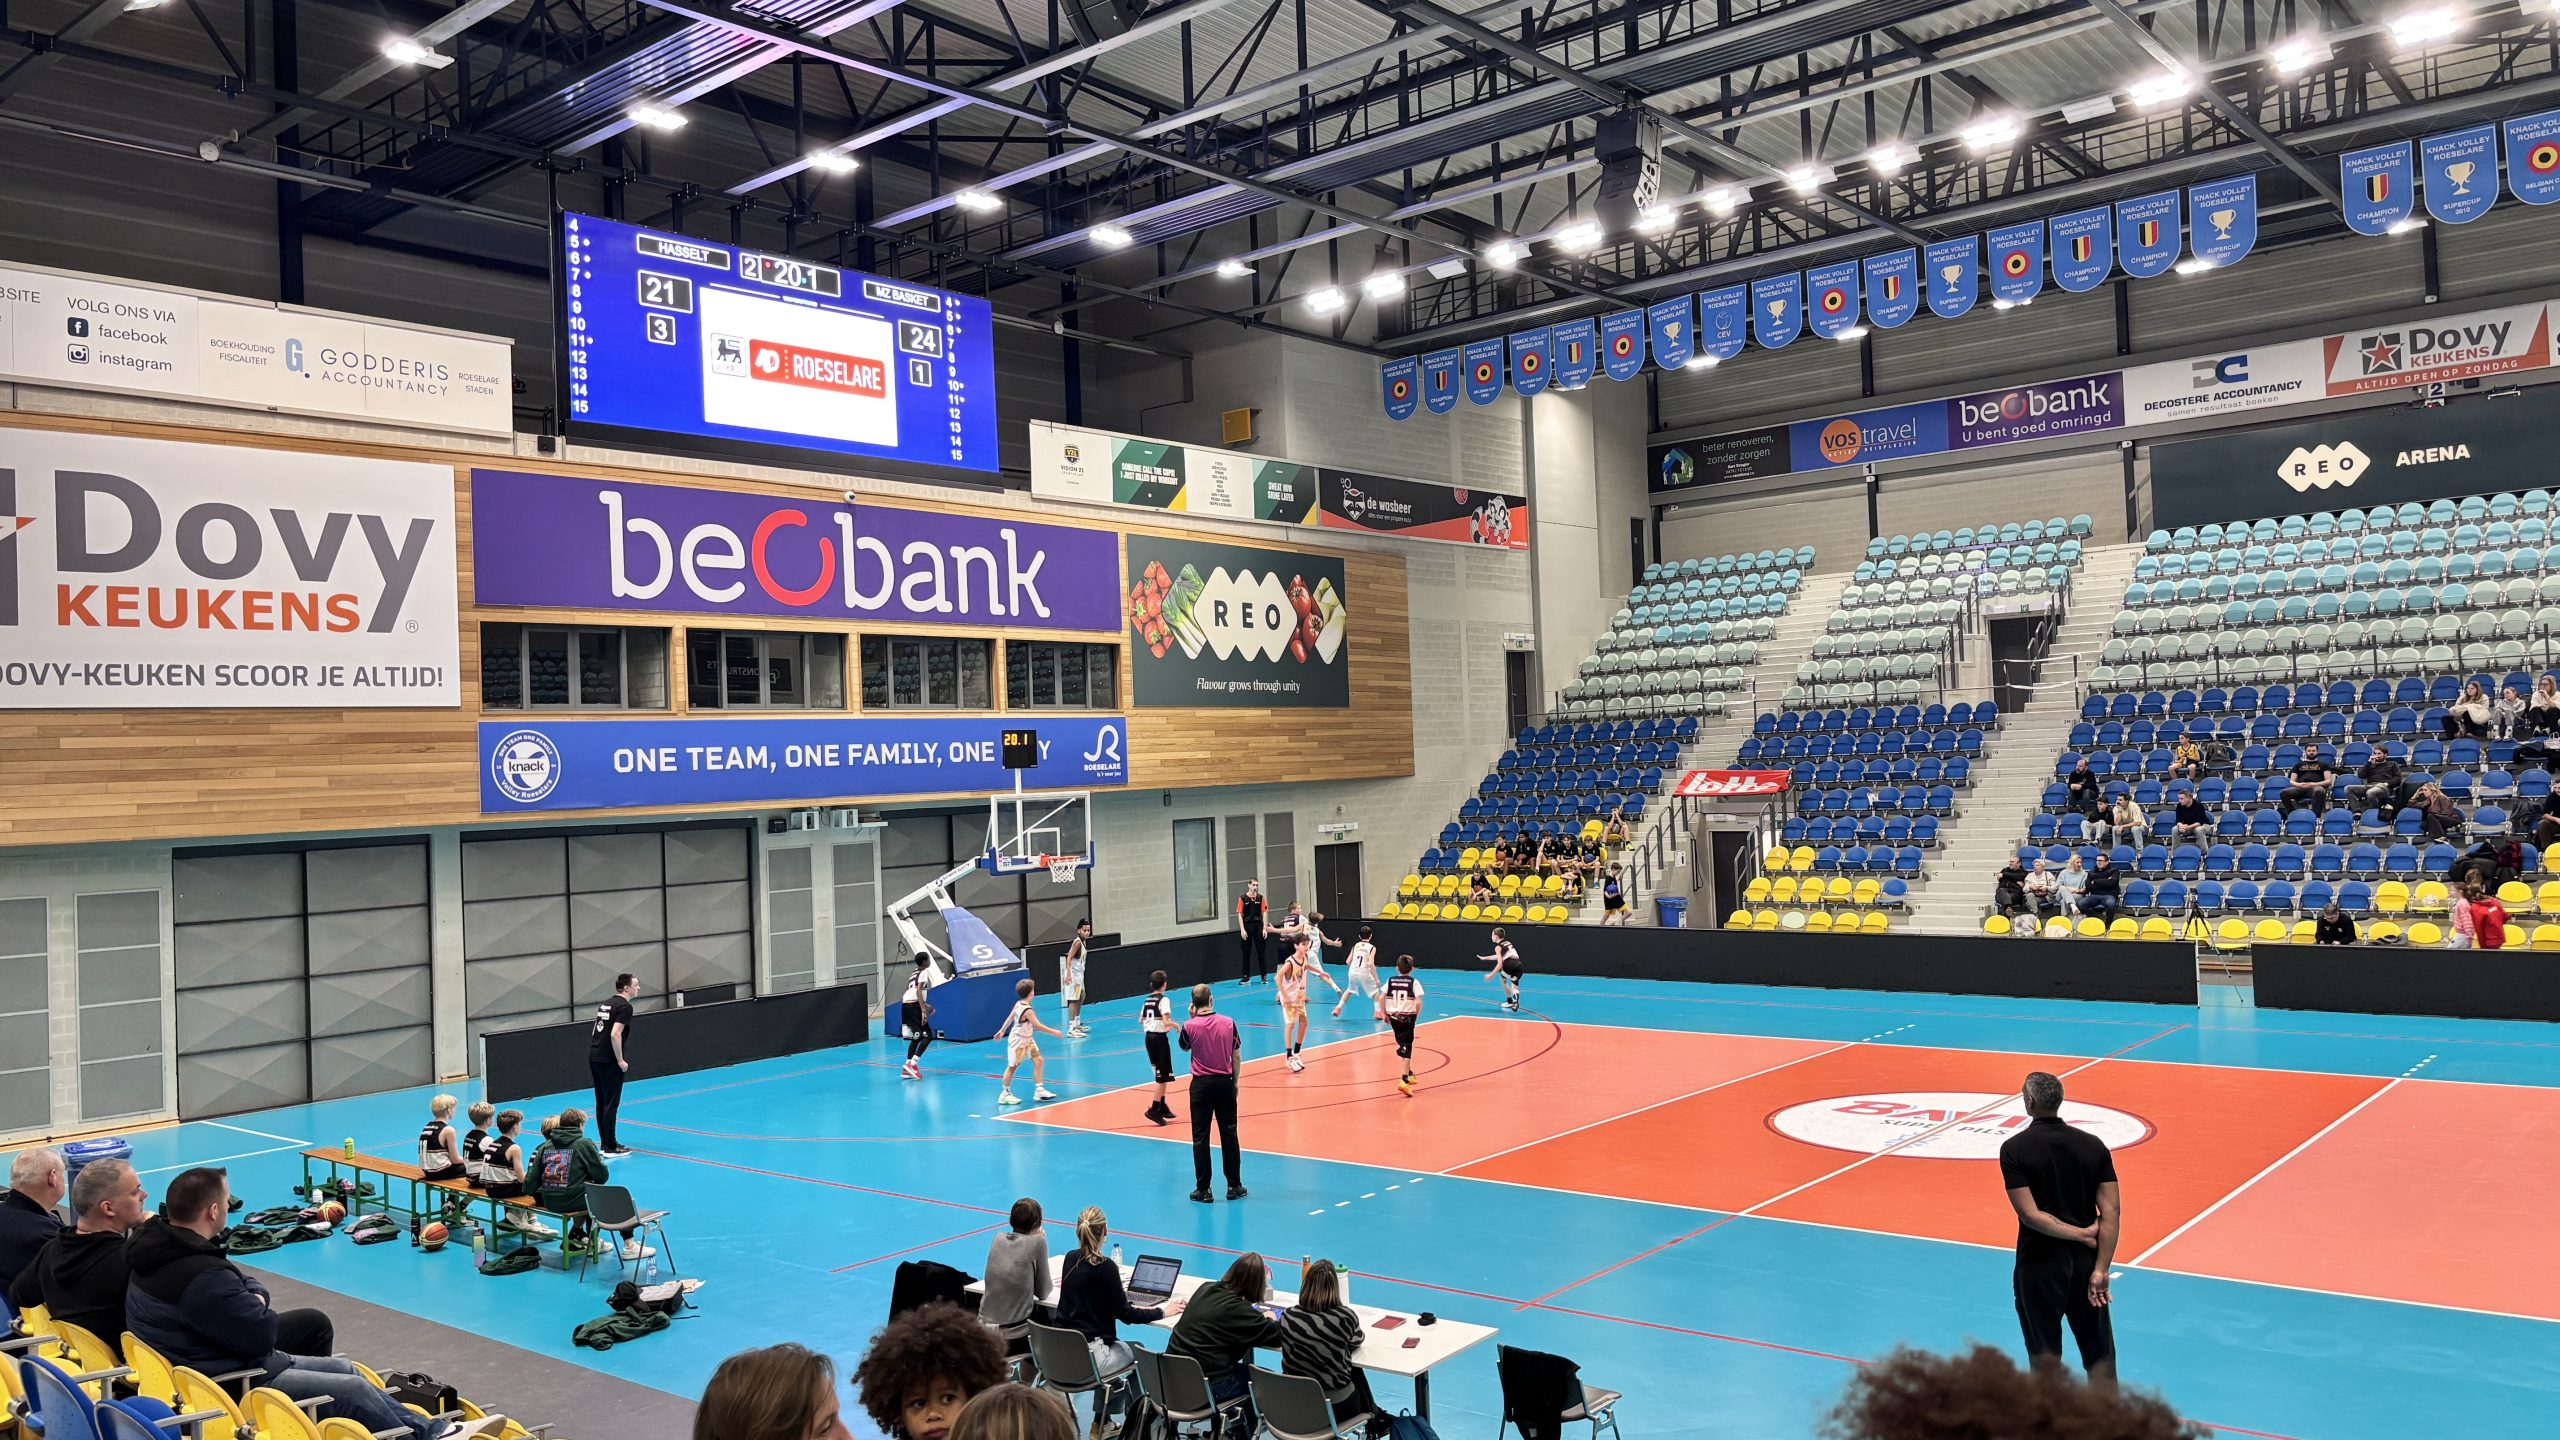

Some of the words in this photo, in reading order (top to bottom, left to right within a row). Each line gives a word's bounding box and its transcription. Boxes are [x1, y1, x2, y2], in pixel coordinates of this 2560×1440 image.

[2510, 122, 2540, 135] KNACK
[2542, 118, 2560, 128] VOL
[2426, 142, 2456, 155] KNACK
[2458, 136, 2490, 148] VOLLEY
[2346, 156, 2374, 168] KNACK
[2376, 149, 2407, 162] VOLLEY
[2434, 145, 2484, 162] ROESELARE
[2352, 159, 2401, 174] ROESELARE
[2525, 178, 2554, 190] BELGIAN
[2194, 192, 2220, 203] KNACK
[2221, 185, 2251, 196] VOLLEY
[2200, 194, 2245, 208] ROESELARE
[2120, 204, 2145, 215] KNACK
[2146, 198, 2175, 210] VOLLEY
[2443, 197, 2482, 210] SUPERCUP
[2126, 206, 2170, 220] ROESELARE
[2357, 206, 2400, 221] CHAMPION
[2455, 206, 2470, 216] 2010
[568, 218, 578, 232] 4
[2054, 220, 2078, 230] KNACK
[2079, 214, 2106, 224] VOLLEY
[2371, 217, 2386, 226] 2010
[1991, 234, 2014, 244] KNACK
[2014, 228, 2040, 238] VOLLEY
[2060, 222, 2100, 236] ROESELARE
[570, 235, 580, 248] 5
[1996, 236, 2036, 249] ROESELARE
[658, 241, 710, 262] HASSELT
[2206, 243, 2240, 255] SUPERCUP
[570, 252, 580, 264] 6
[2130, 252, 2168, 264] CHAMPION
[744, 256, 757, 277] 2
[2064, 266, 2101, 278] CHAMPION
[571, 268, 581, 281] 7
[572, 284, 582, 298] 8
[646, 277, 675, 305] 21
[876, 286, 891, 299] MZ
[892, 288, 929, 308] BASKET
[572, 301, 582, 314] 9
[946, 296, 953, 308] 4
[67, 297, 110, 314] VOLG
[114, 304, 149, 320] ONS
[153, 309, 176, 324] VIA
[946, 311, 953, 322] 5
[570, 318, 586, 331] 10
[654, 319, 668, 340] 3
[946, 324, 954, 336] 6
[98, 324, 168, 346] facebook
[570, 334, 586, 348] 11
[910, 327, 936, 352] 24
[2408, 320, 2512, 356] Dovy
[210, 338, 275, 354] BOEKHOUDING
[948, 338, 955, 350] 7
[99, 350, 172, 372] instagram
[219, 352, 268, 366] FISCALITEIT
[572, 350, 588, 364] 12
[948, 352, 956, 364] 8
[2410, 346, 2490, 368] KEUKENS
[320, 348, 450, 381] GODDERIS
[948, 366, 956, 377] 9
[458, 372, 500, 385] ROESELARE
[572, 367, 588, 380] 13
[793, 354, 882, 391] ROESELARE
[916, 364, 924, 382] 1
[2356, 376, 2400, 390] ALTIJD
[2404, 371, 2438, 383] OPEN
[2442, 368, 2460, 379] OP
[2465, 358, 2518, 375] ZONDAG
[322, 370, 448, 396] ACCOUNTANCY
[948, 380, 960, 391] 10
[2430, 383, 2443, 396] 2
[466, 385, 494, 396] STADEN
[572, 384, 588, 397] 14
[2144, 394, 2210, 412] DECOSTERE
[2212, 380, 2303, 402] ACCOUNTANCY
[948, 394, 960, 405] 11
[2167, 408, 2198, 418] samen
[2200, 400, 2244, 414] resultaat
[2246, 394, 2279, 407] boeken
[573, 400, 588, 414] 15
[949, 408, 961, 420] 12
[950, 422, 962, 433] 13
[1824, 432, 1857, 449] VOS
[1862, 417, 1917, 444] travel
[1962, 431, 1972, 442] U
[1976, 426, 2008, 440] bent
[2012, 420, 2046, 438] goed
[2051, 411, 2112, 430] omringd
[950, 436, 962, 447] 14
[1702, 442, 1726, 453] beter
[1727, 435, 1774, 449] renoveren,
[952, 450, 962, 460] 15
[1706, 453, 1738, 464] zonder
[1740, 448, 1770, 460] zorgen
[2294, 456, 2354, 478] REO
[2395, 444, 2471, 466] ARENA
[1866, 463, 1872, 474] 1
[1268, 482, 1282, 492] SWEAT
[1281, 492, 1294, 502] LATER
[1367, 496, 1377, 510] de
[1378, 500, 1412, 514] wasbeer
[54, 469, 435, 634] Dovy
[56, 584, 361, 634] KEUKENS
[1214, 600, 1281, 631] REO
[214, 664, 310, 688] SCOOR
[317, 666, 345, 688] JE
[352, 666, 444, 688] ALTIJD!
[1196, 677, 1228, 691] Flavour
[1228, 680, 1252, 693] grows
[1252, 680, 1282, 694] through
[1282, 682, 1300, 694] unity
[508, 735, 522, 746] TEAM
[536, 738, 554, 756] FAMILY
[1004, 734, 1028, 746] 20.1
[612, 746, 680, 774] ONE
[686, 746, 778, 774] TEAM,
[784, 742, 842, 770] ONE
[848, 741, 943, 768] FAMILY,
[948, 740, 996, 764] ONE
[508, 760, 544, 772] knack
[1084, 763, 1120, 772] ROESELARE
[501, 779, 520, 798] Volley
[521, 778, 553, 798] Roeselare
[1880, 1119, 1943, 1129] SUPE
